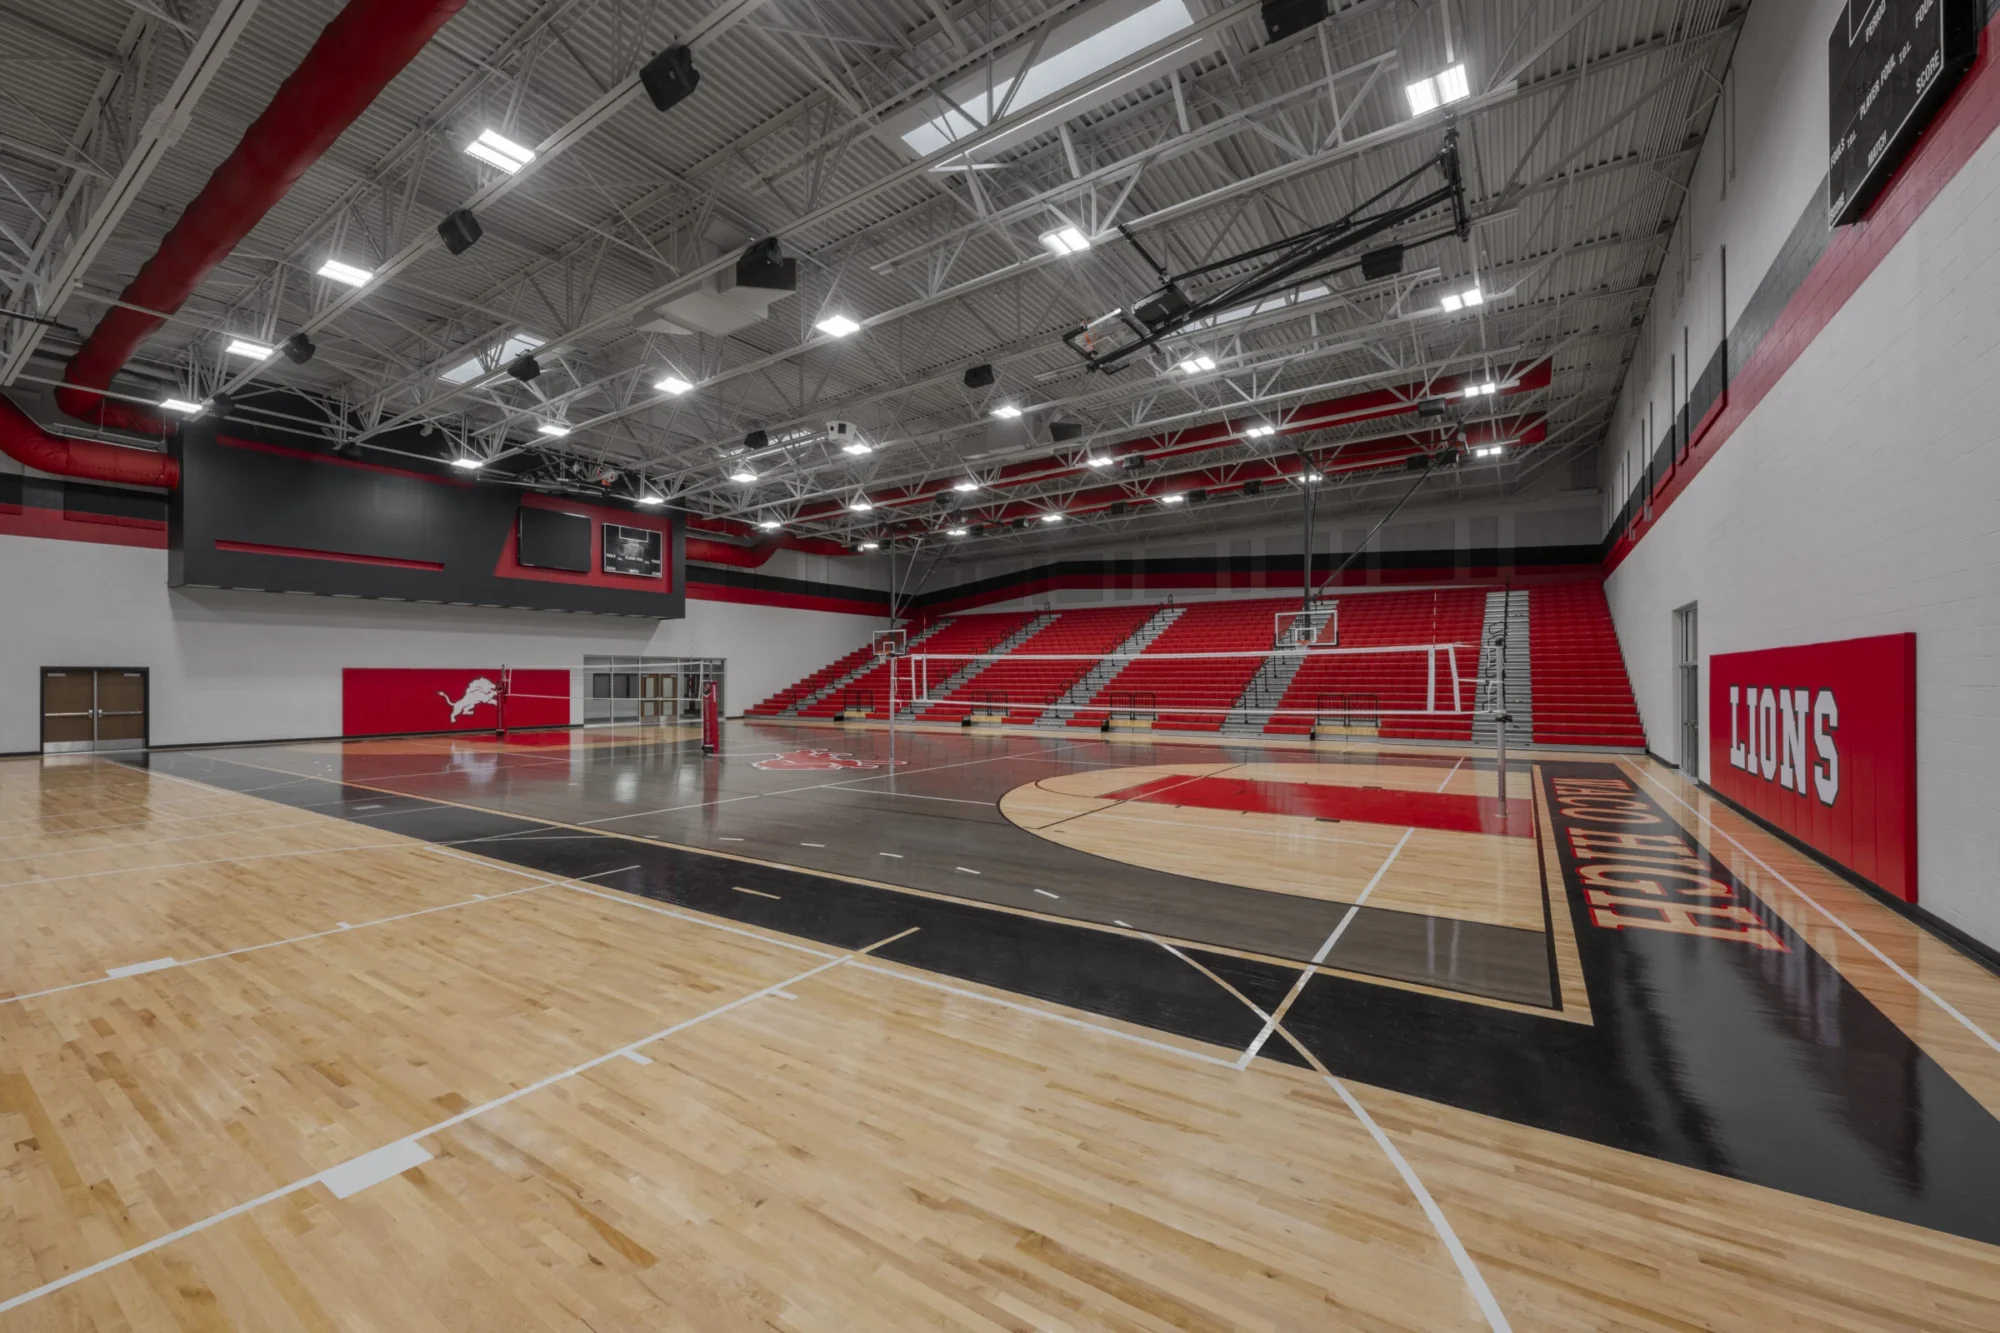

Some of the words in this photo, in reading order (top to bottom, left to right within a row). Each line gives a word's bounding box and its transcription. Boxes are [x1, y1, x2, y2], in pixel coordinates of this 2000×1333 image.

[1860, 79, 1880, 120] PLAYER
[1881, 53, 1896, 87] FOUL
[1916, 49, 1940, 95] SCORE
[1830, 137, 1845, 170] FOULS
[1868, 129, 1887, 168] MATCH
[1729, 683, 1840, 809] LIONS
[1551, 777, 1662, 824] WACO
[1565, 826, 1793, 954] HIGH
